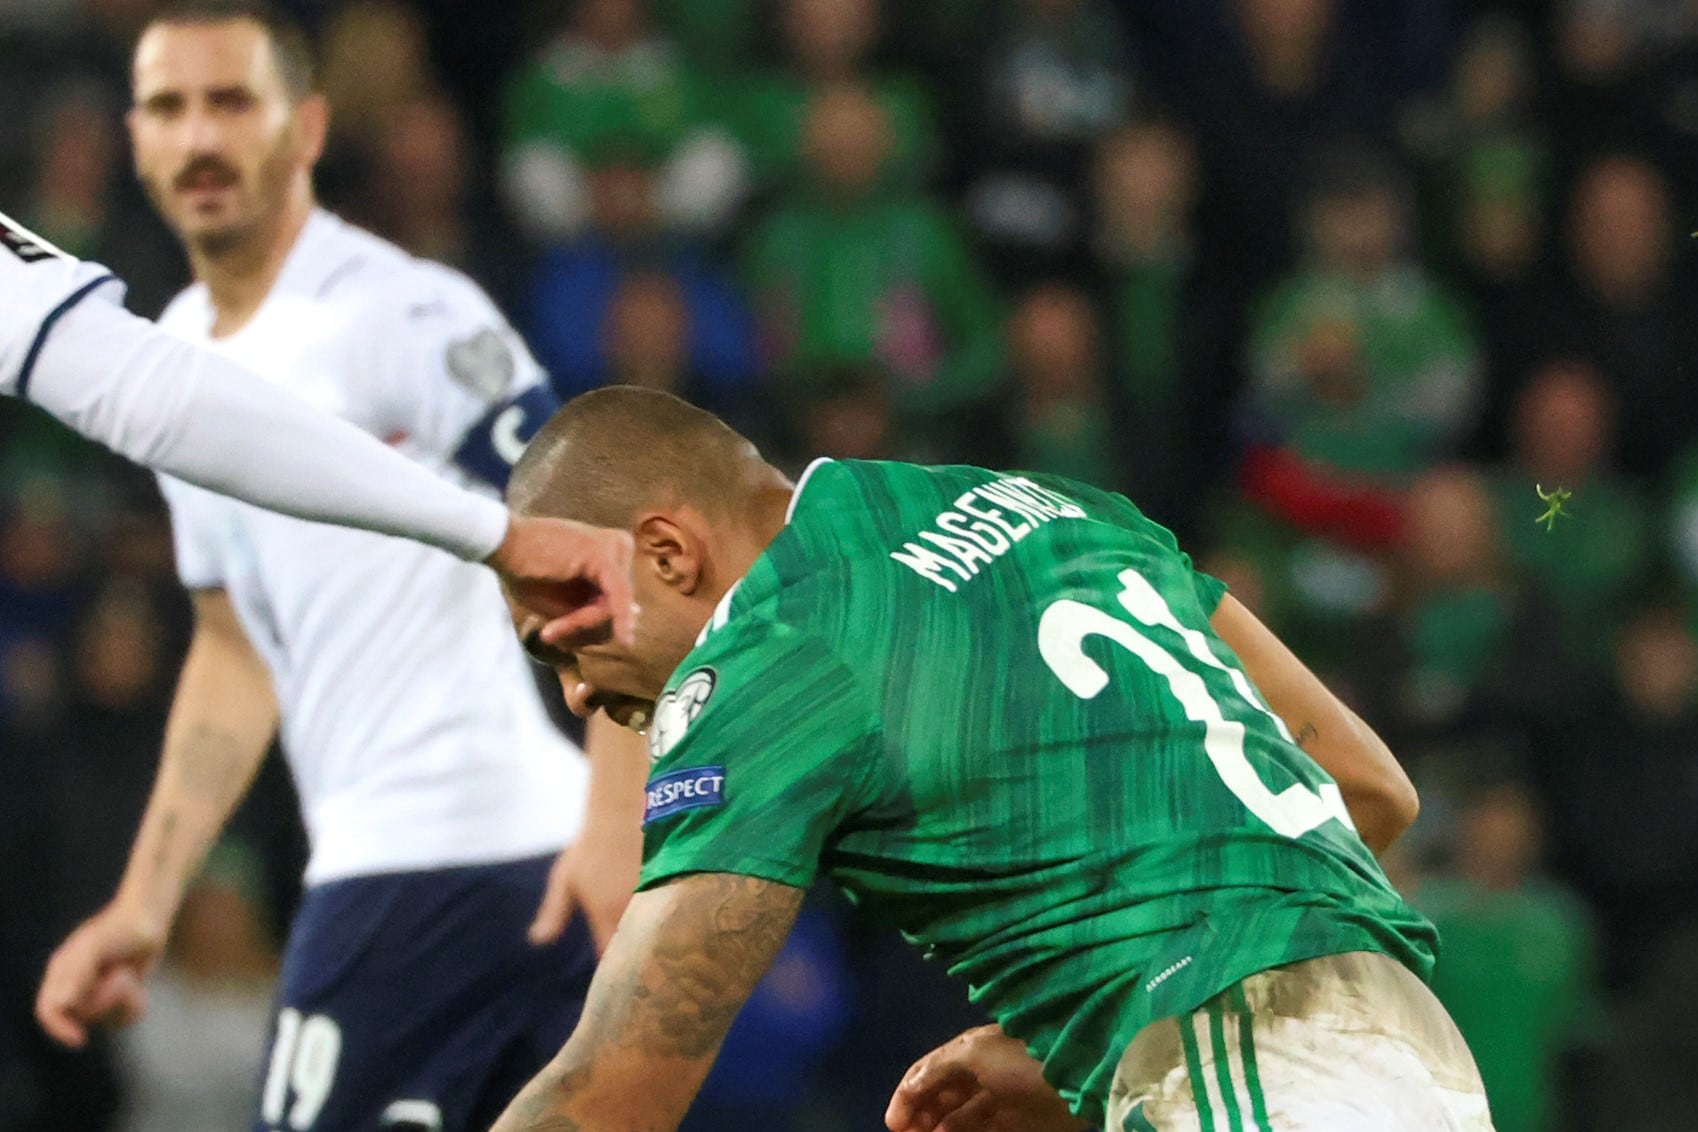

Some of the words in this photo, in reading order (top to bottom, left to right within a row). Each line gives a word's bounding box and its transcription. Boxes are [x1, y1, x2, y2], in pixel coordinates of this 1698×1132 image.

[1037, 567, 1357, 840] 21
[646, 775, 724, 810] RESPECT
[262, 1006, 342, 1132] 19
